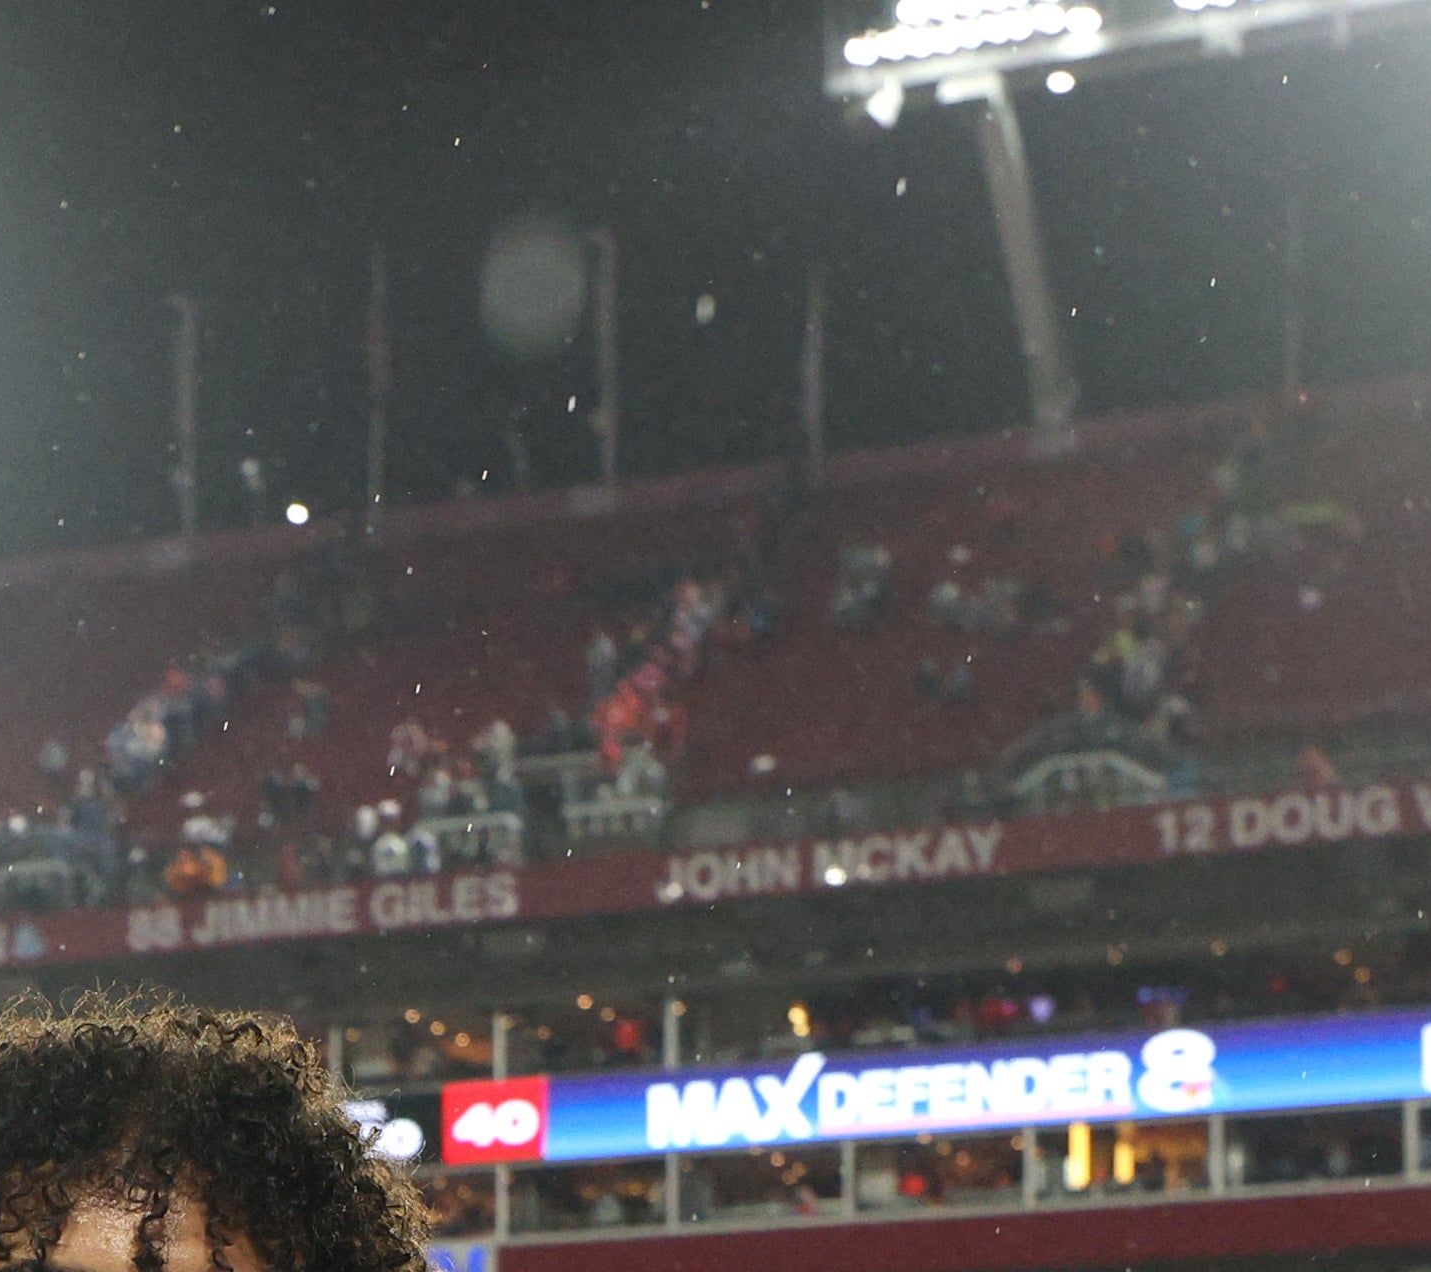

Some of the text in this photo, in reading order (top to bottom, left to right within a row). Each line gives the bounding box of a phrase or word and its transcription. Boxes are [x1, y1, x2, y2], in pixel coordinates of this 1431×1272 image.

[1157, 812, 1217, 854] 12
[1231, 791, 1399, 848] DOUG
[655, 823, 1005, 905] JOHN MCKAY
[194, 889, 356, 944] JIMMIE
[370, 874, 520, 930] GILES
[452, 1098, 540, 1147] 40
[644, 1027, 1216, 1150] MAX DEFENDER 8
